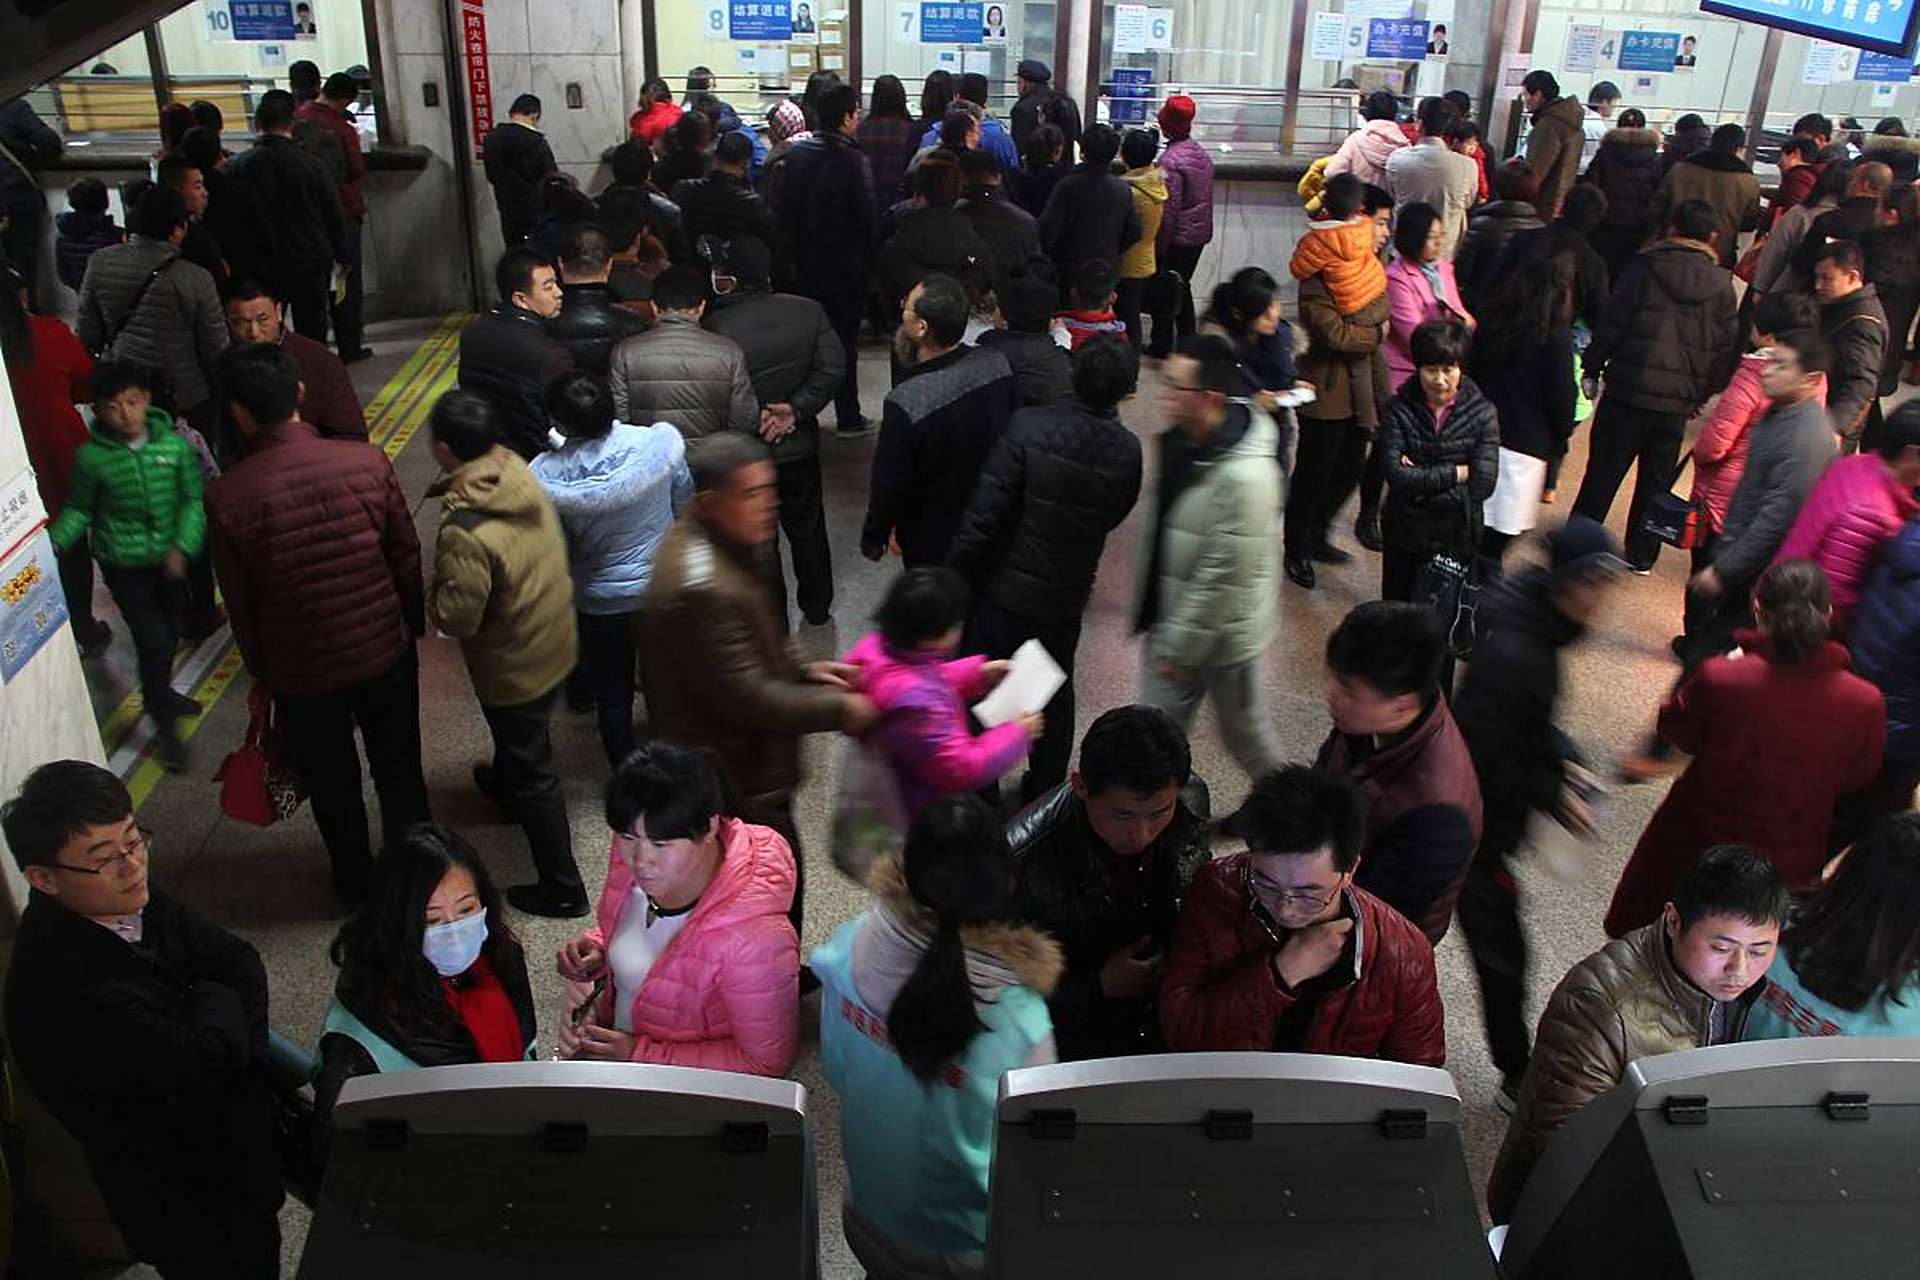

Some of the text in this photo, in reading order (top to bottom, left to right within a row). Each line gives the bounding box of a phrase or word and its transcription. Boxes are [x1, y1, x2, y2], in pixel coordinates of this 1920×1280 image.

[207, 10, 229, 30] 10
[710, 9, 724, 30] 8
[901, 12, 914, 32] 7
[1152, 18, 1166, 39] 6
[1348, 26, 1363, 47] 5
[1601, 39, 1615, 60] 4
